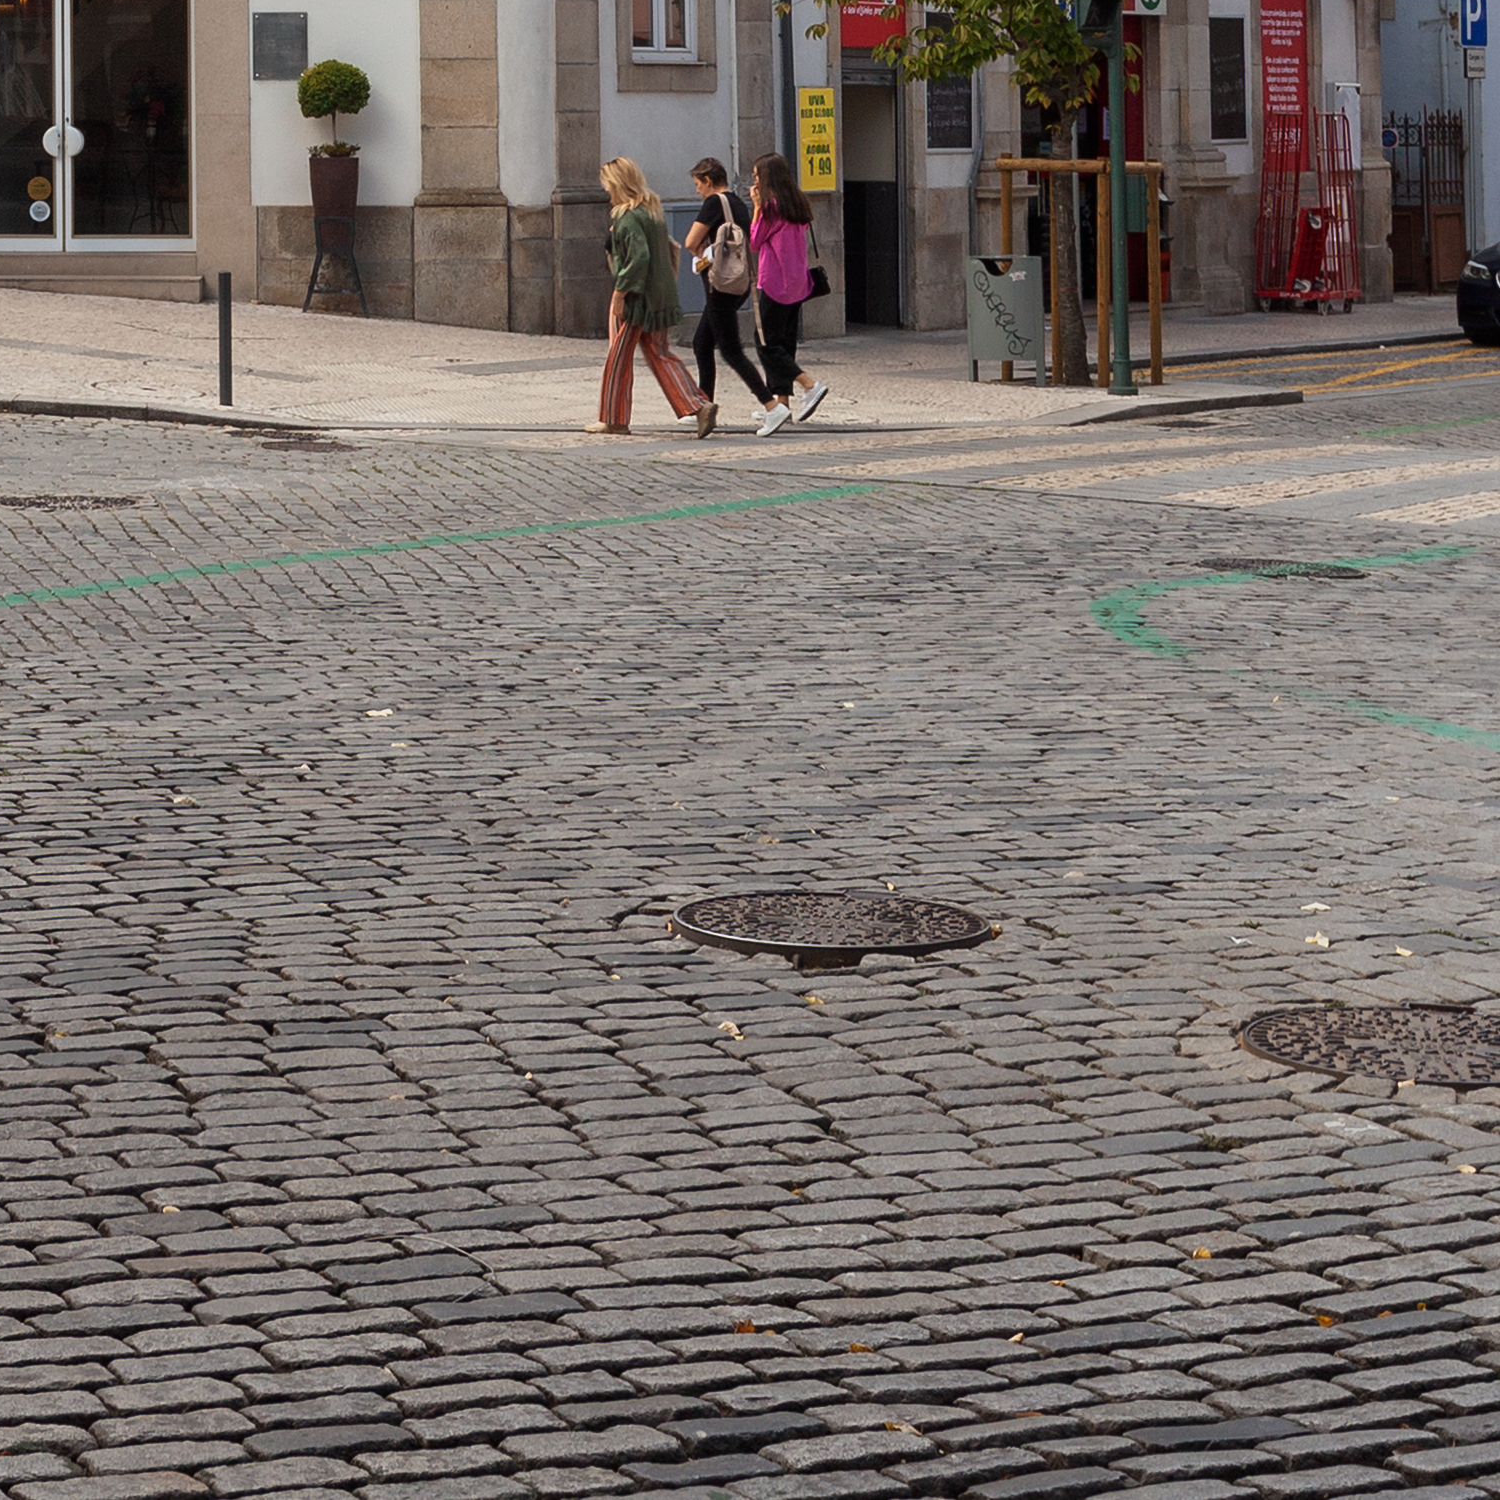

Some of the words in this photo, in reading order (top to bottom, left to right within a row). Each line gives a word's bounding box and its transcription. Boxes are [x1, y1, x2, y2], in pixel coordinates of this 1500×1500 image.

[808, 95, 826, 106] UVA
[800, 108, 813, 119] RED
[806, 144, 830, 155] AGORA
